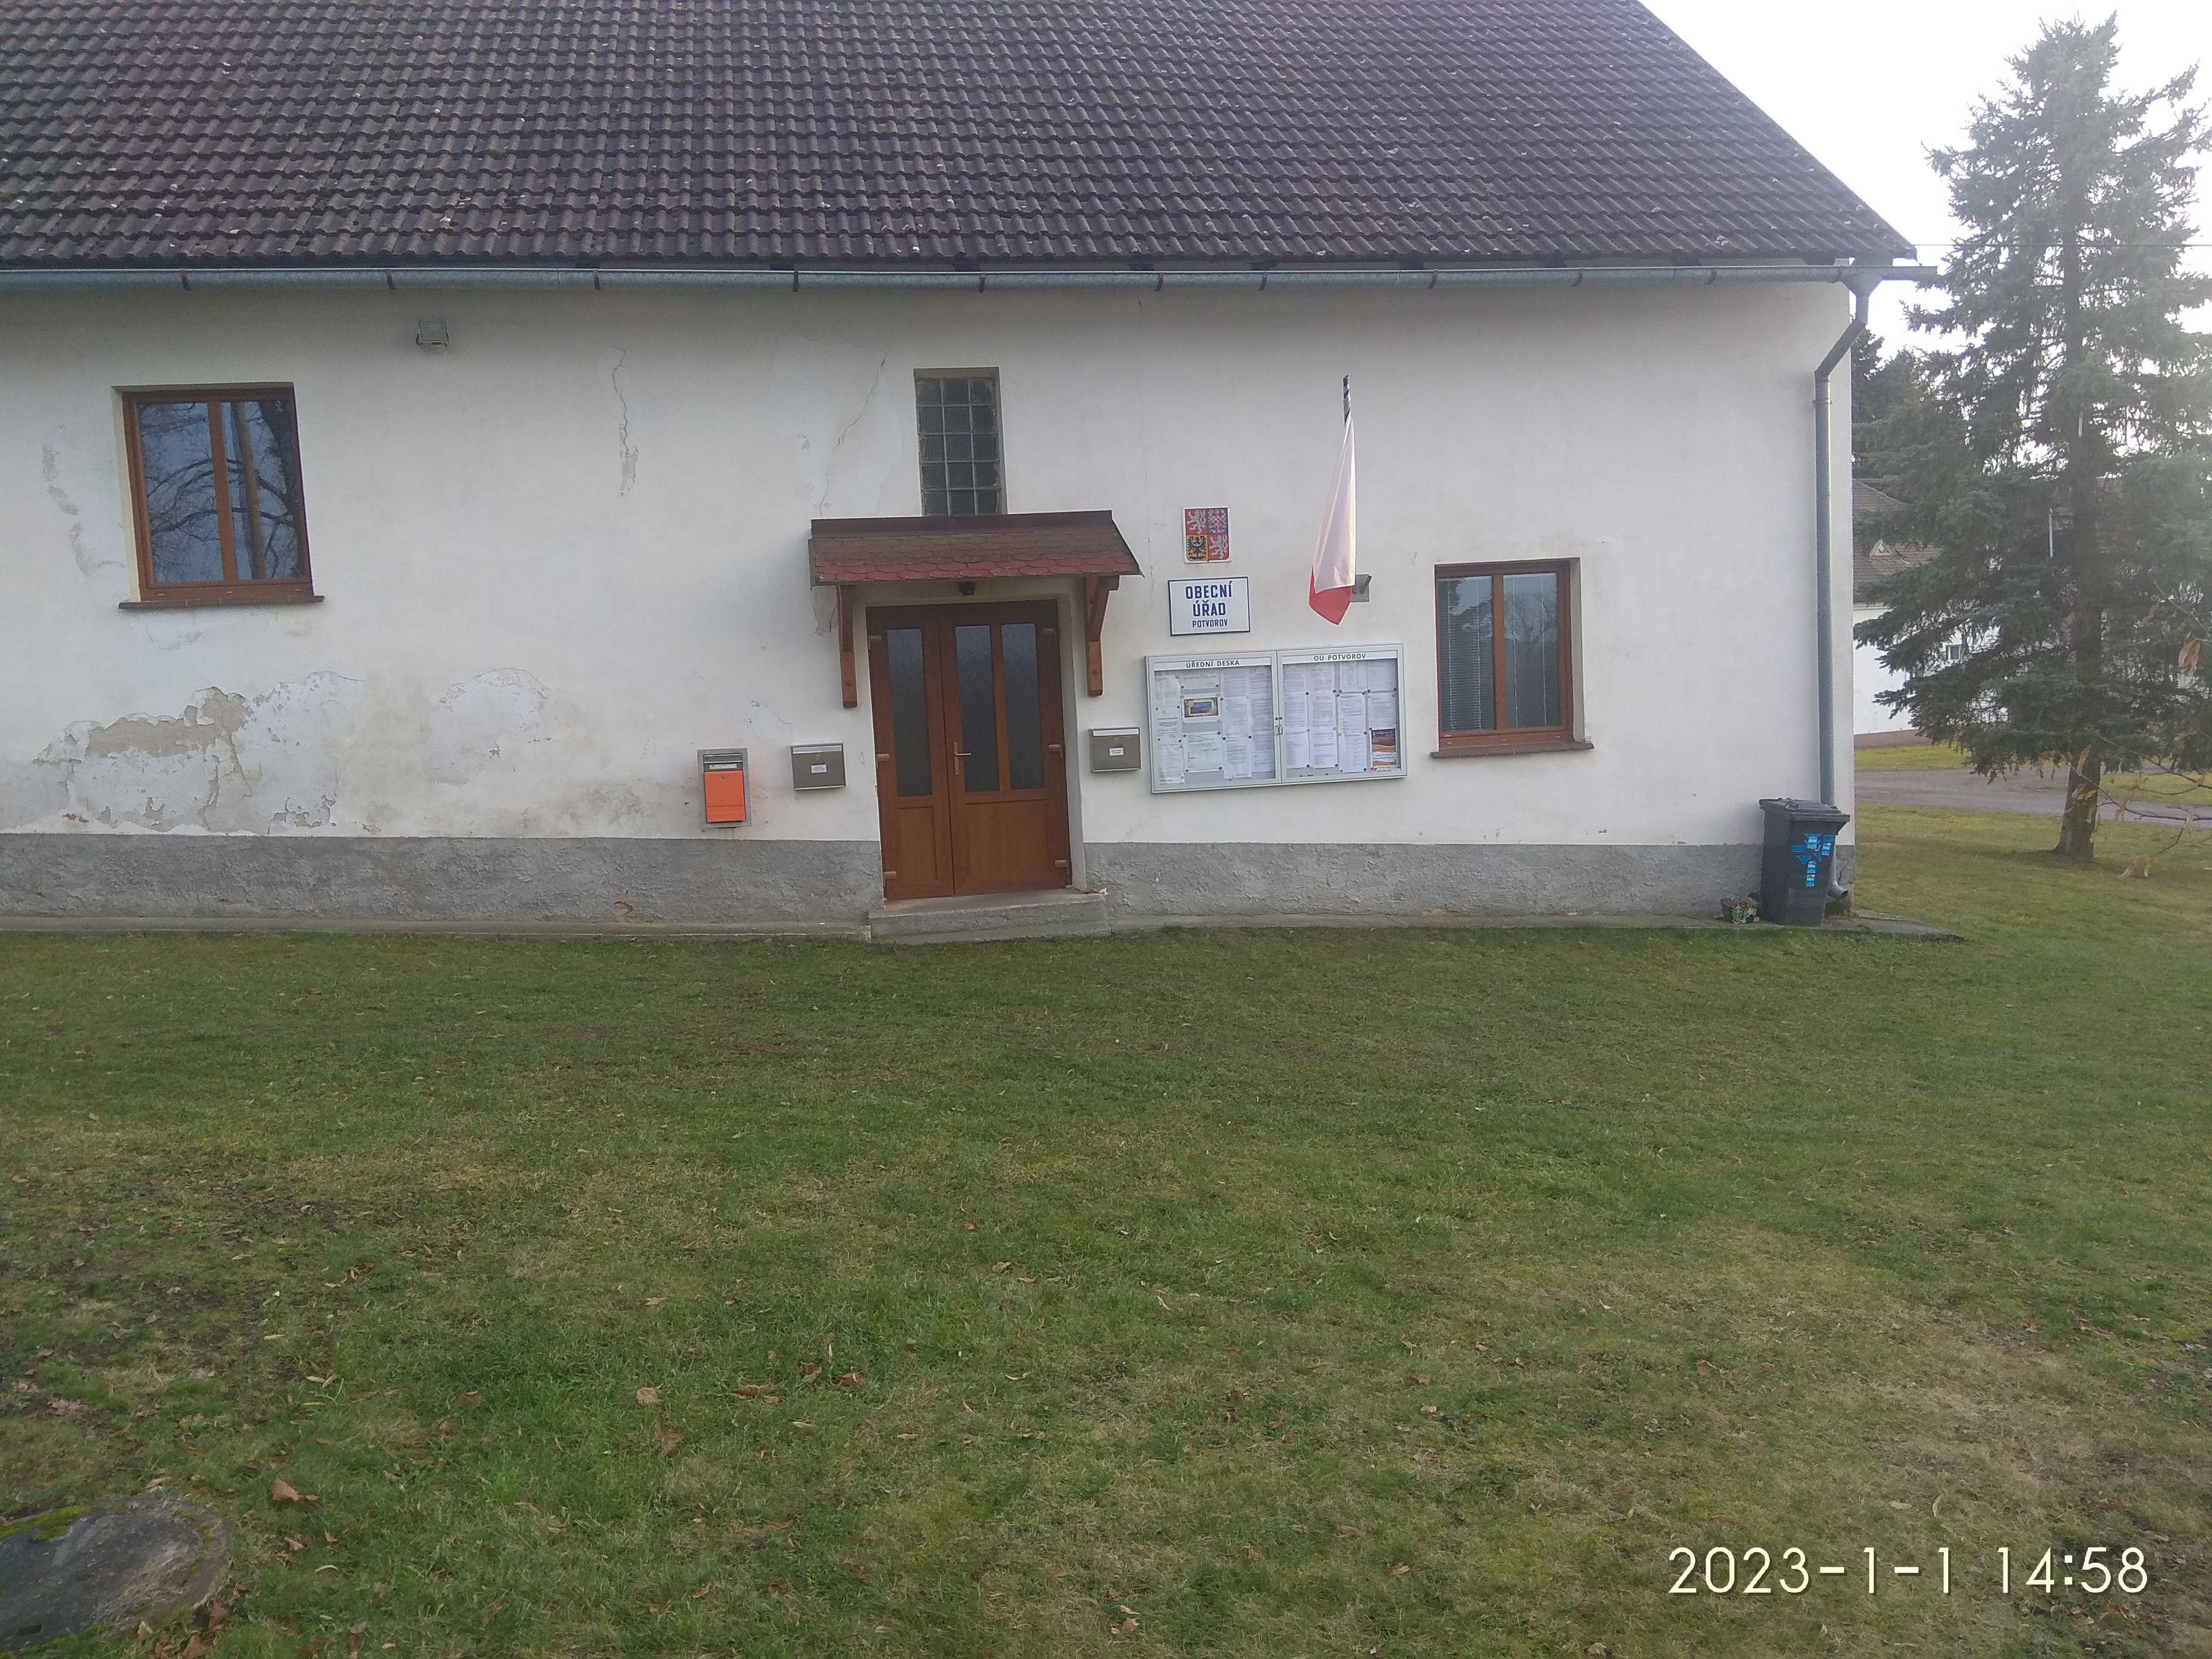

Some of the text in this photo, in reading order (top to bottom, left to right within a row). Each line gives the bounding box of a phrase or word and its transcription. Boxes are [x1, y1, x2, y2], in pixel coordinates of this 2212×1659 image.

[1186, 581, 1233, 599] OBECNÍ
[1193, 600, 1226, 617] ÚŘAD
[1192, 619, 1228, 628] POTVOROV
[1186, 660, 1213, 668] ÚŘEDNÍ
